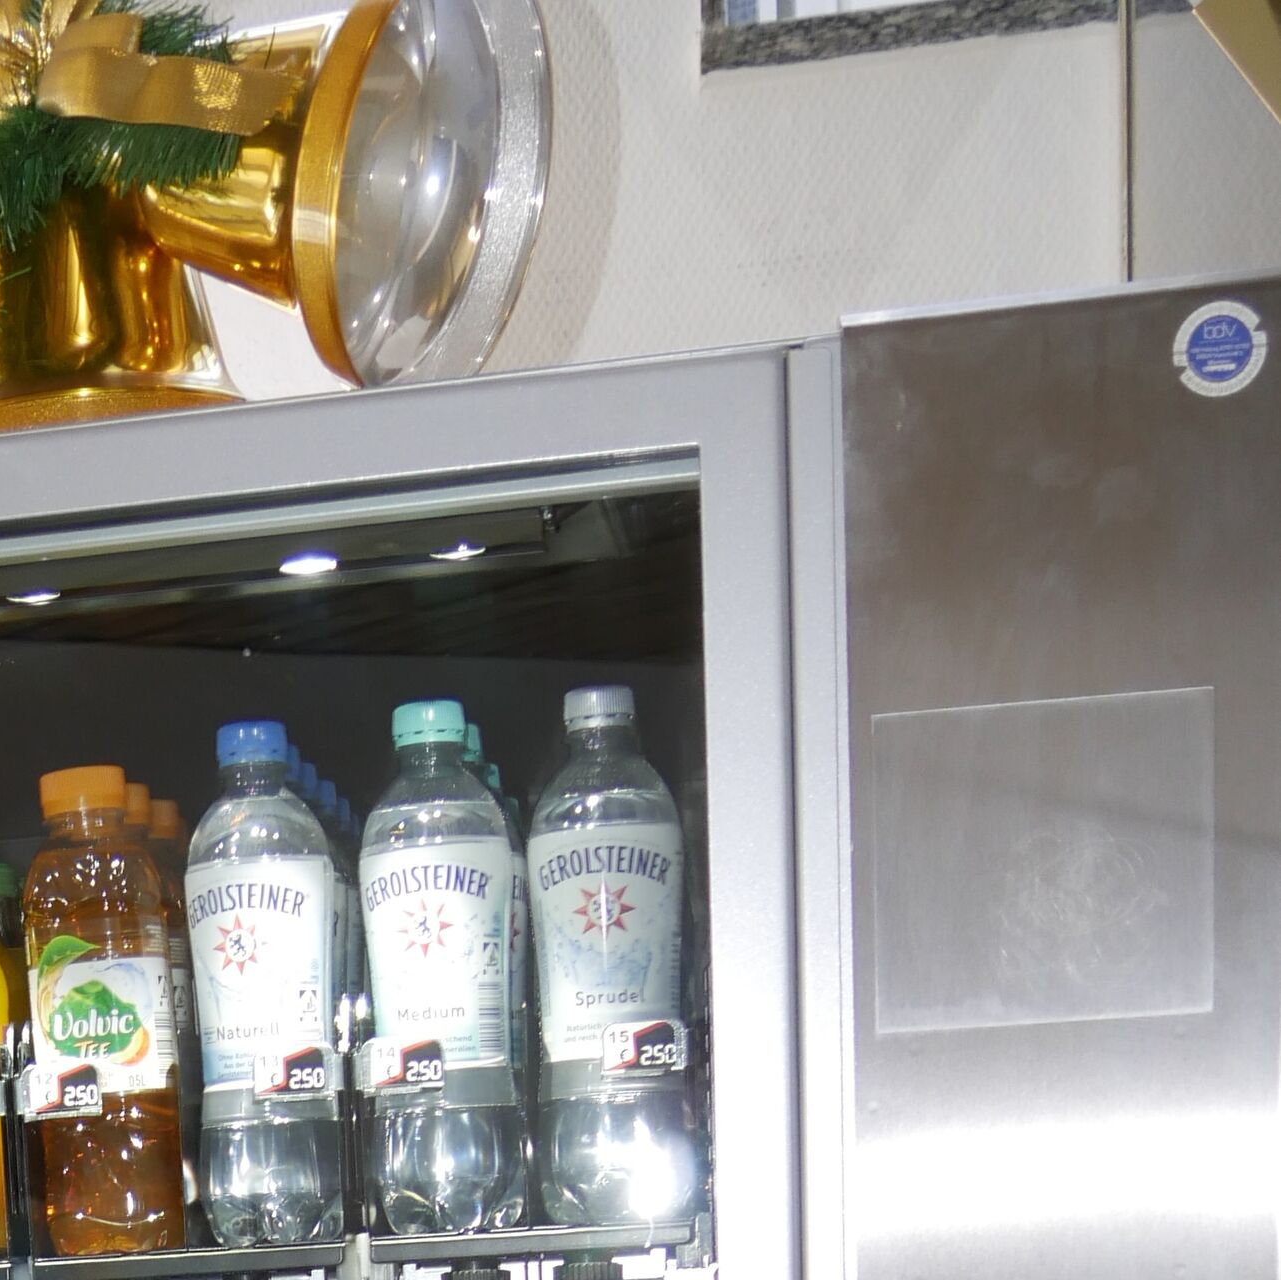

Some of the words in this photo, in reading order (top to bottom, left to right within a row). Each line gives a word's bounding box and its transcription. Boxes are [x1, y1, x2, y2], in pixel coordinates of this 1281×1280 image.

[540, 845, 671, 890] GEROLSTEINER
[366, 864, 490, 911] GEROLSTEINER
[188, 883, 306, 928] GEROLSTEINER
[575, 988, 644, 1008] Sprudel
[398, 1005, 465, 1021] Medium
[53, 1008, 134, 1041] Volvic
[217, 1022, 279, 1040] Naturell
[609, 1031, 629, 1043] 15
[74, 1040, 110, 1058] TEE
[378, 1047, 395, 1058] 14
